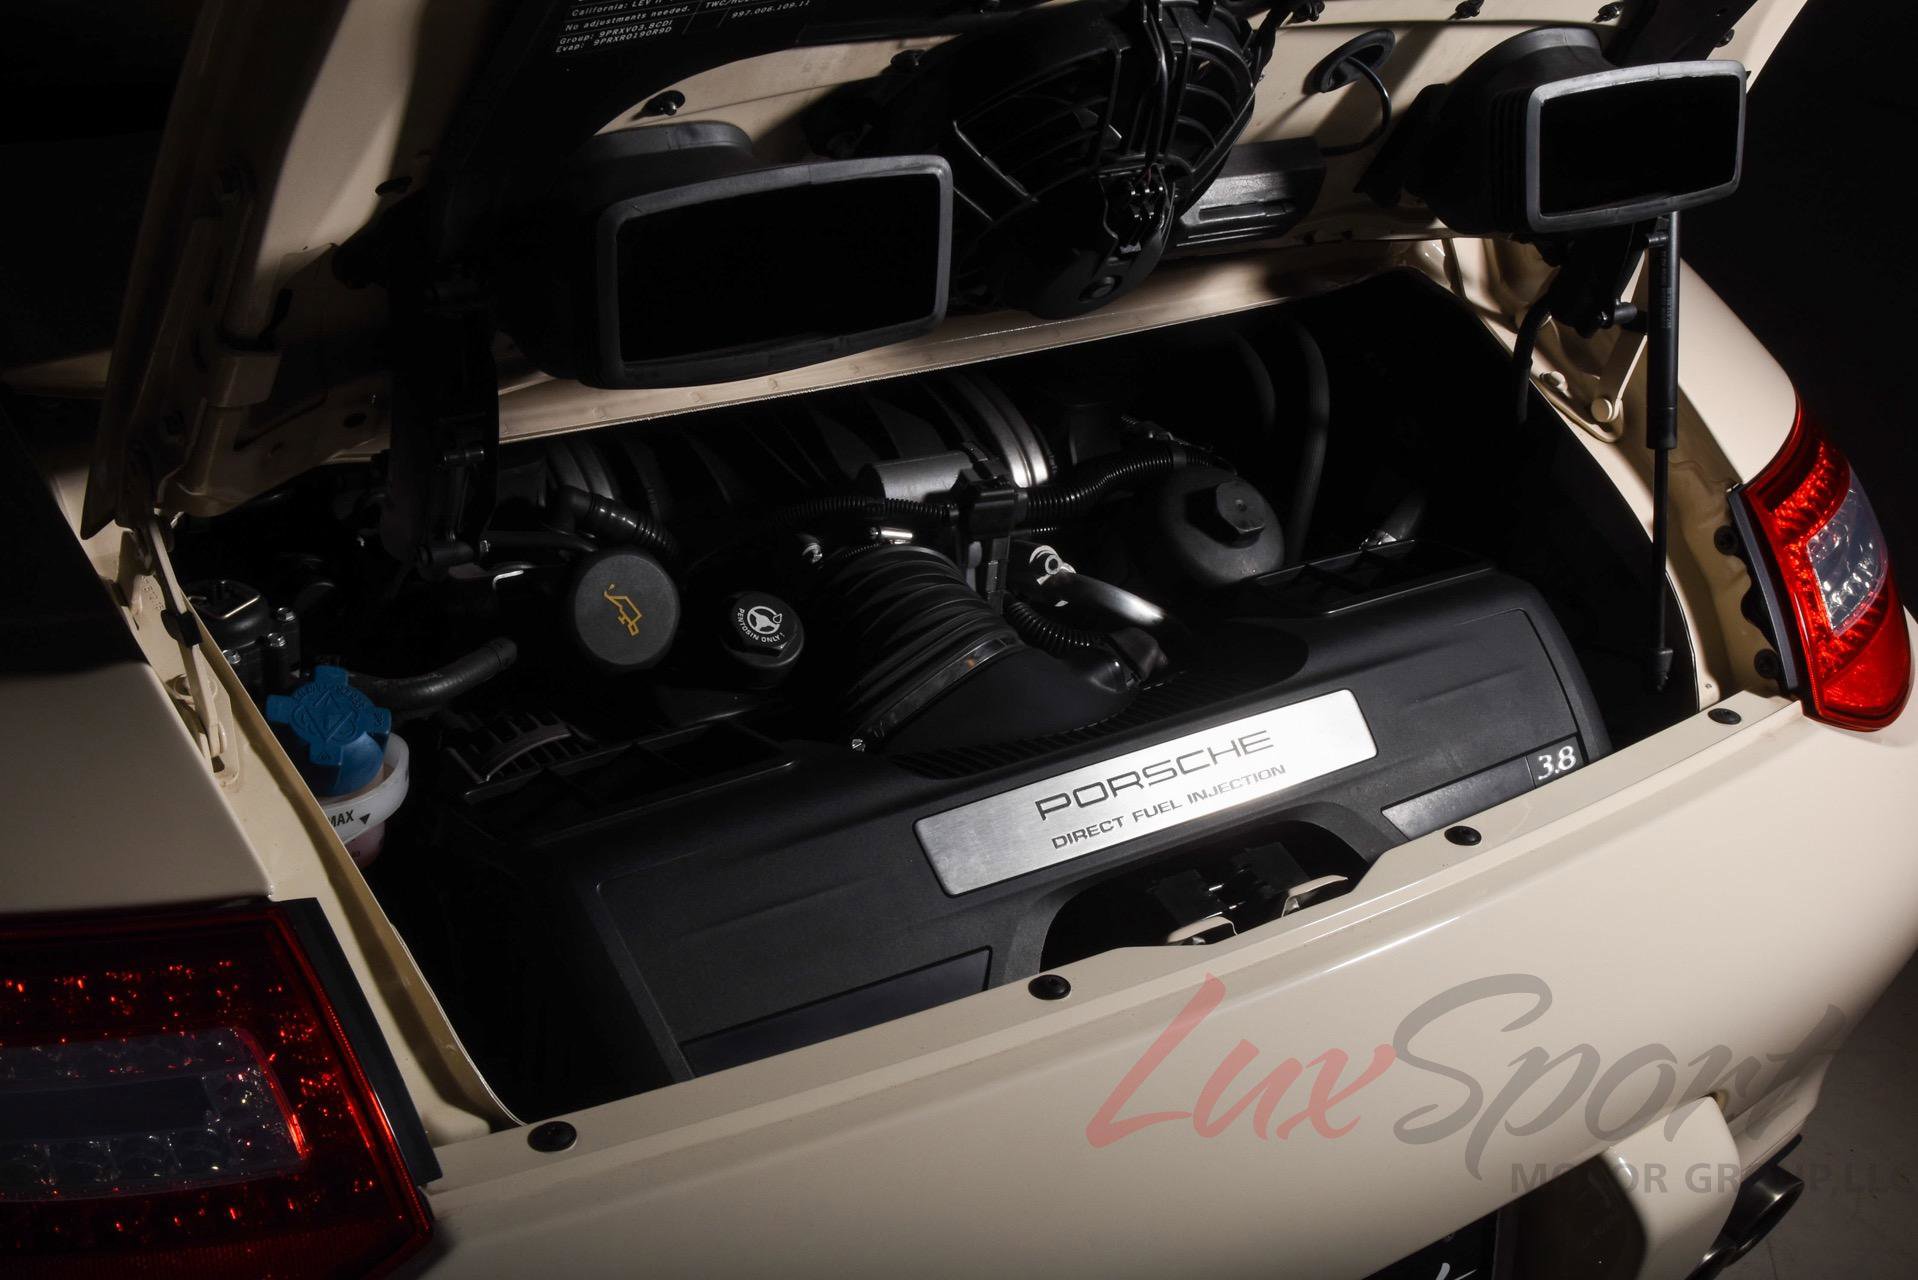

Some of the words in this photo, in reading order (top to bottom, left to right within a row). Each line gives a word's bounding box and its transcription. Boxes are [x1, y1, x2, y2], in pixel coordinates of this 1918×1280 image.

[571, 3, 628, 17] California:
[583, 13, 647, 29] adjustments
[650, 5, 690, 17] needed.
[555, 43, 585, 53] Evap:
[559, 34, 594, 45] Group:
[737, 607, 760, 641] PENTOSIN
[1034, 730, 1275, 821] PORSCHE
[1538, 745, 1576, 780] 3.8
[1051, 815, 1125, 849] DIRECT
[1132, 799, 1183, 823] FUEL
[1187, 764, 1287, 804] INJECTION
